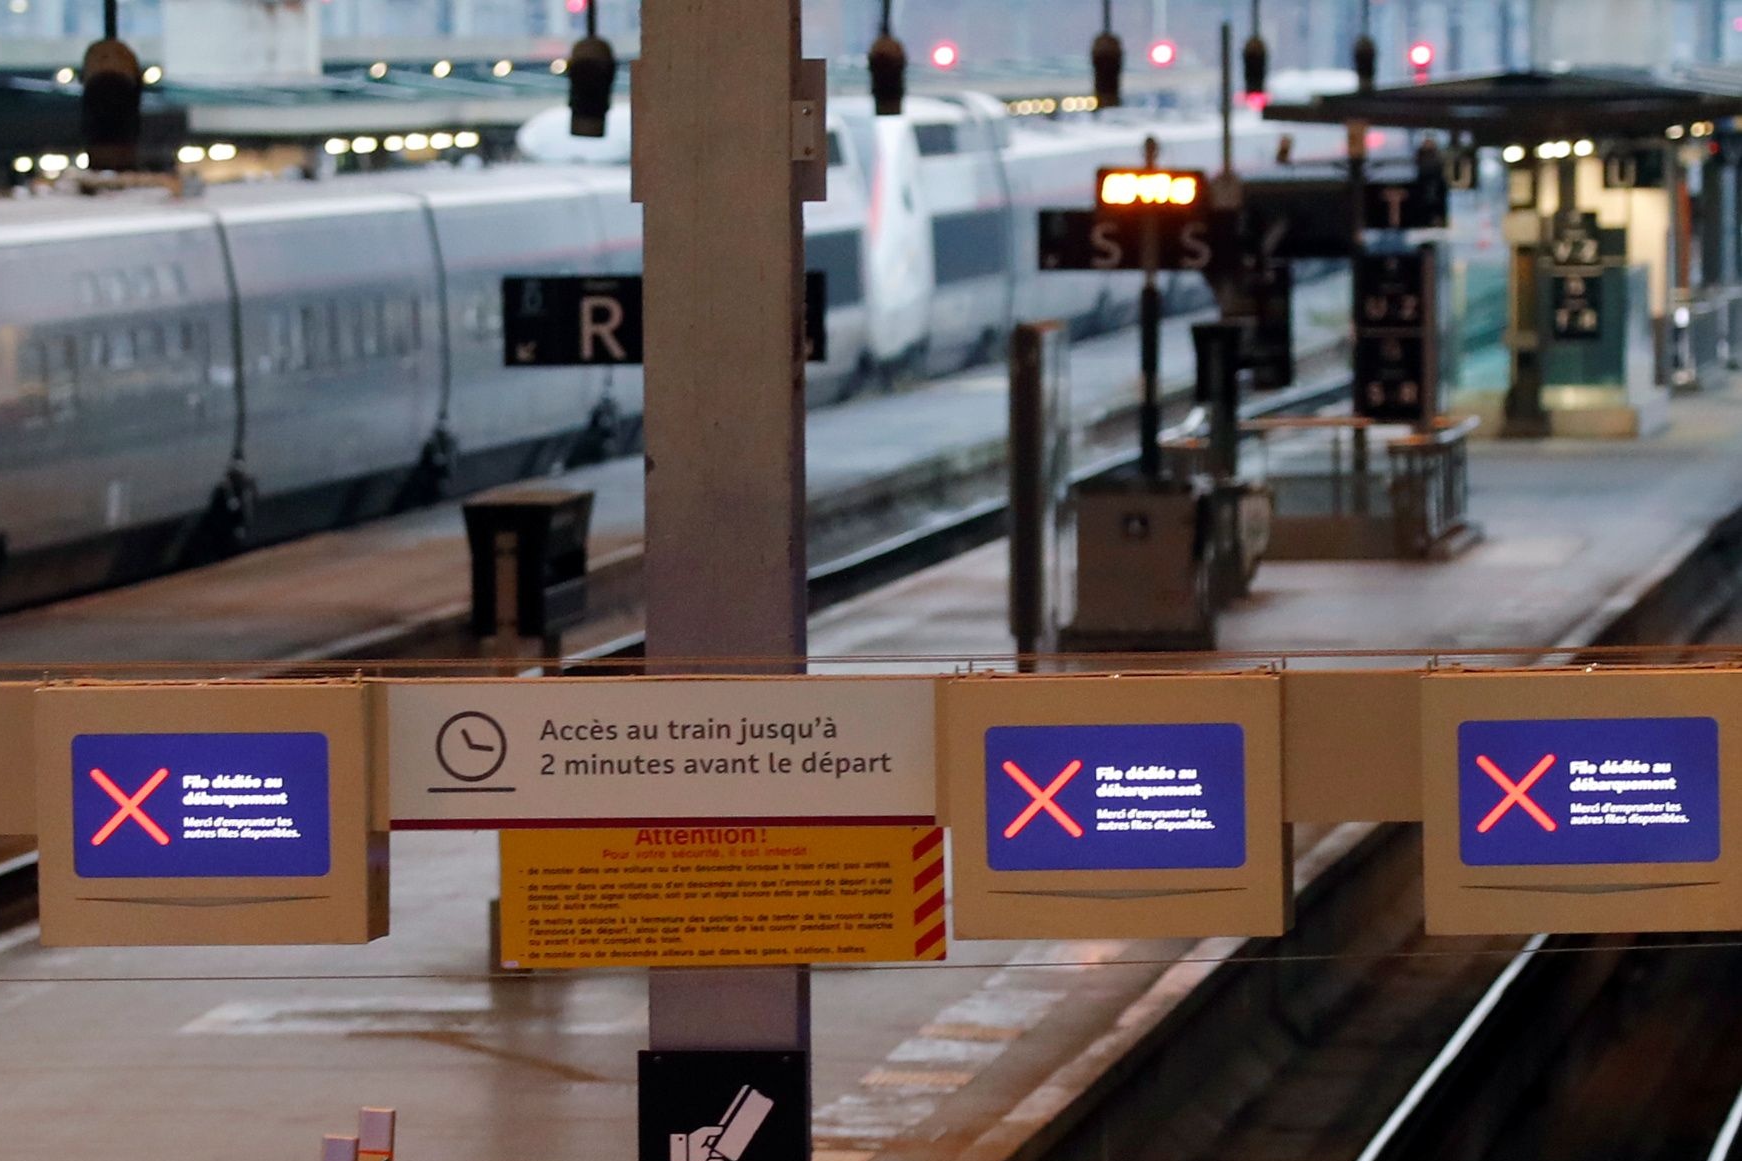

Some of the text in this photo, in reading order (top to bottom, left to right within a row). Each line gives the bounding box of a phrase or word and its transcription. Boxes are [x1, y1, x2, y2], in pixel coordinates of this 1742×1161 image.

[1091, 221, 1122, 269] S
[581, 296, 626, 360] R
[539, 717, 838, 745] Accès au train jusqu'à
[540, 751, 892, 778] 2 minutes avant le départ
[1570, 760, 1671, 774] File dédiée au
[1096, 766, 1197, 780] File dédiée au
[183, 774, 283, 788] File dédiée au
[1570, 777, 1677, 794] débarquement
[1096, 783, 1202, 800] débarquement
[182, 791, 288, 808] débarquement
[1096, 808, 1126, 819] Merci
[1191, 808, 1207, 819] les
[1570, 802, 1600, 813] Merci
[1665, 802, 1682, 813] les
[183, 817, 213, 827] Merci
[277, 817, 293, 827] les
[1096, 821, 1130, 830] autres
[1570, 815, 1604, 825] autres
[183, 829, 216, 838] autres
